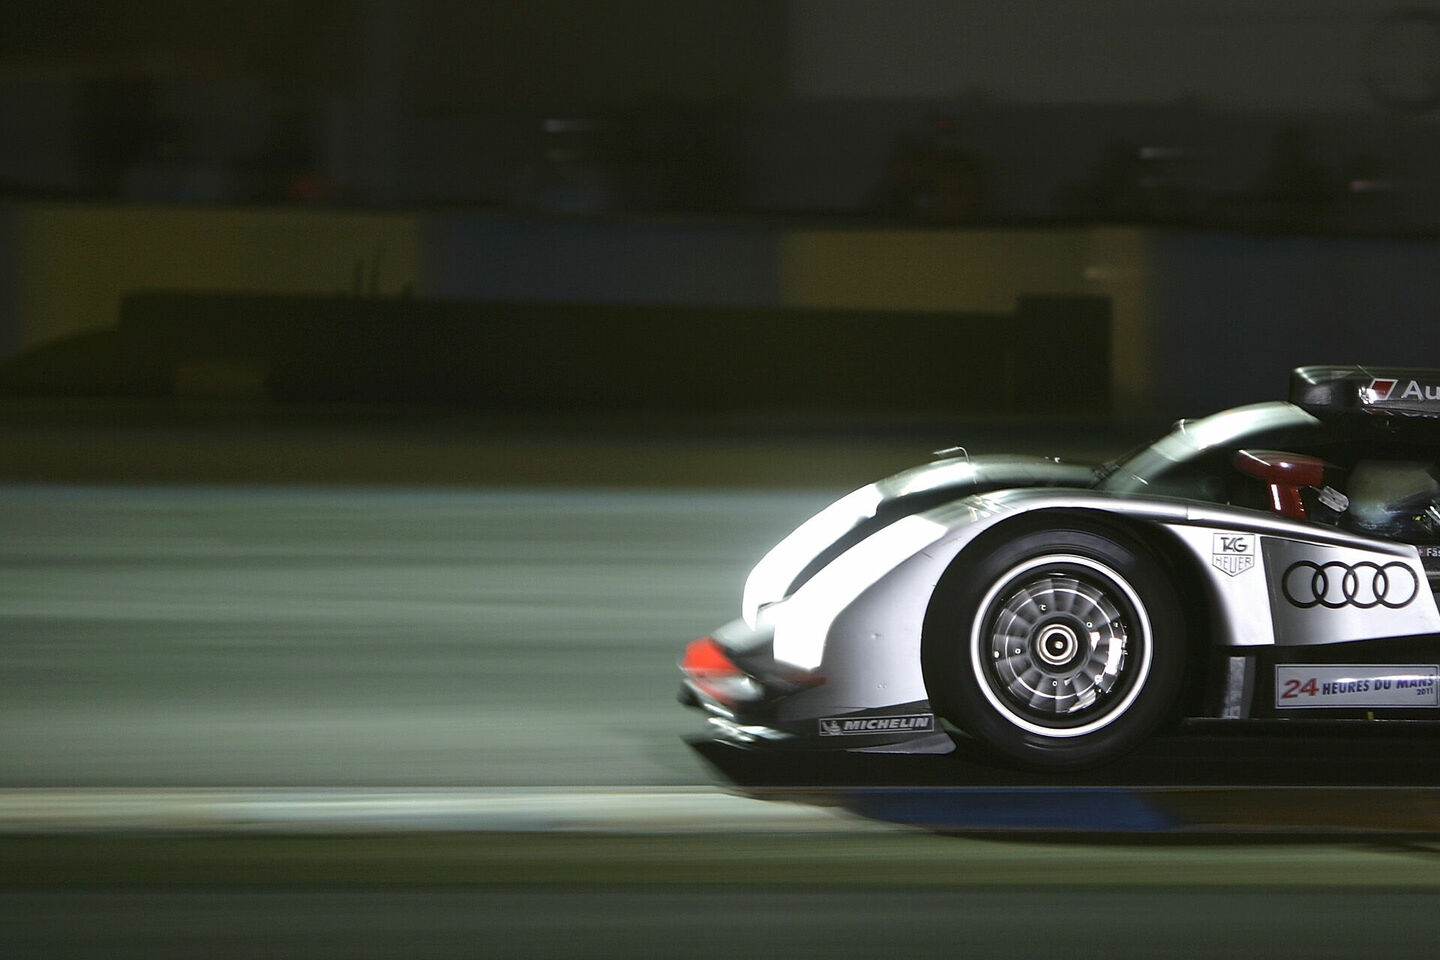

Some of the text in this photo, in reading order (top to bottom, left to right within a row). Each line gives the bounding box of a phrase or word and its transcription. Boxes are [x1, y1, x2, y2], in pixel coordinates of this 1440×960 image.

[1220, 537, 1248, 552] TAG
[1215, 556, 1251, 573] HEUER
[1281, 674, 1435, 699] 24 HEURES DU MANS
[1416, 688, 1434, 696] 2011
[844, 717, 929, 731] MICHELIN
